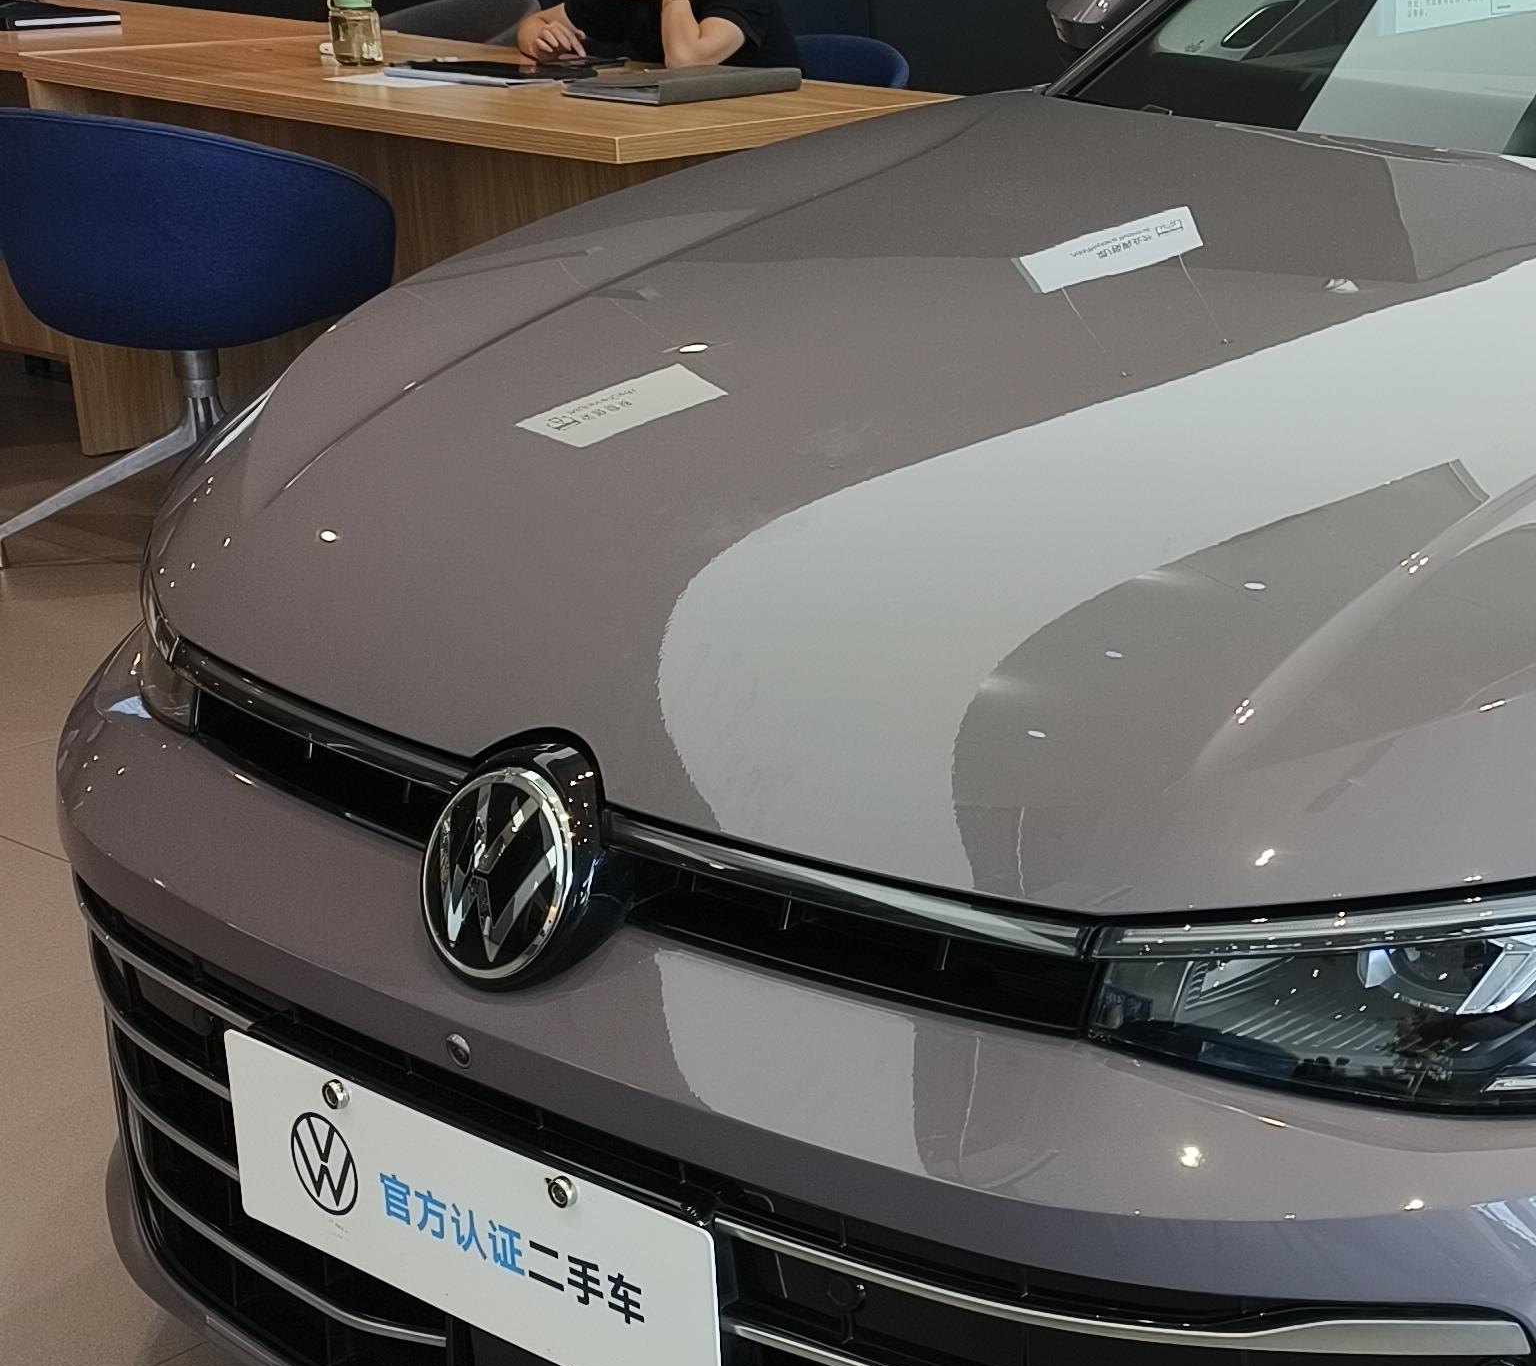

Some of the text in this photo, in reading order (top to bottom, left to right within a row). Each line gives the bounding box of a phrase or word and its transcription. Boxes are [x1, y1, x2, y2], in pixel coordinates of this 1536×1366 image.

[379, 1172, 645, 1325] 官方认证二手车
